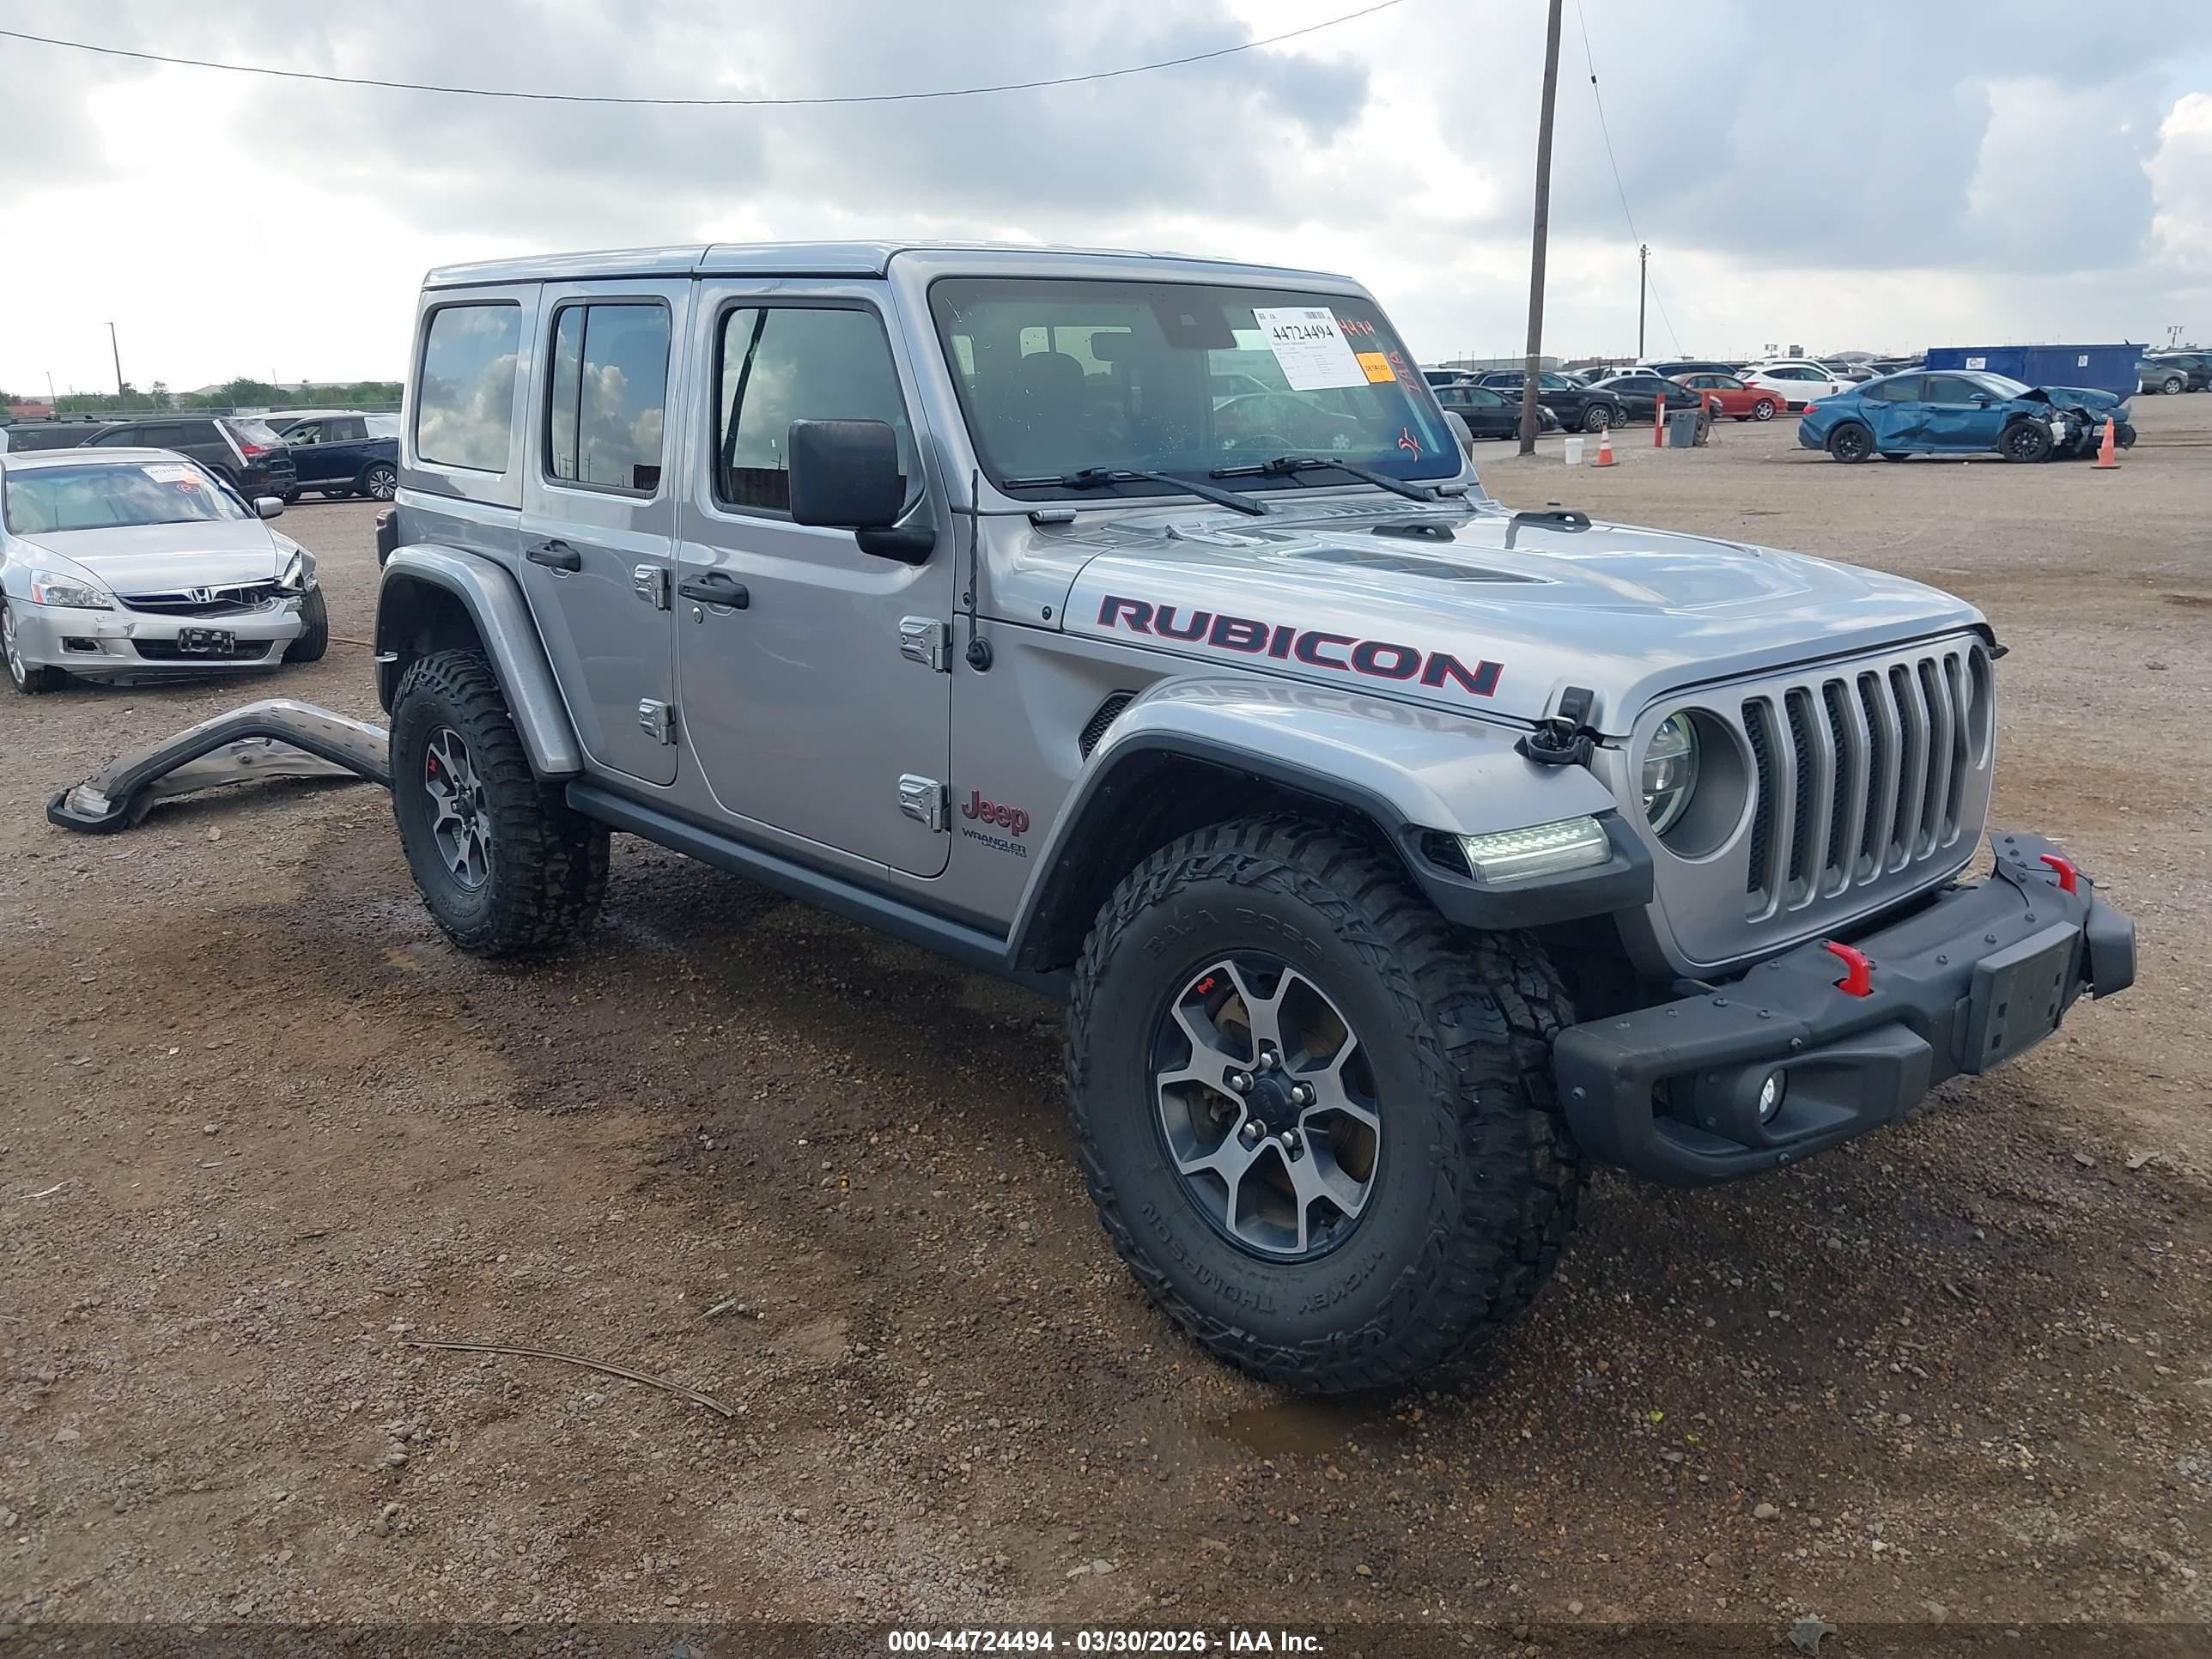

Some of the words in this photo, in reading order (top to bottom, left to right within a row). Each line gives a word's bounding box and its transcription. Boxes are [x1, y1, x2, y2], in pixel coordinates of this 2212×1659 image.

[1273, 325, 1334, 341] 44724494
[1097, 594, 1505, 698] RUBICON
[961, 789, 1030, 838] Jeep
[962, 827, 1027, 854] WRANGLER
[981, 842, 1028, 859] UNLIMITED
[1139, 1202, 1277, 1316] THOMPSON
